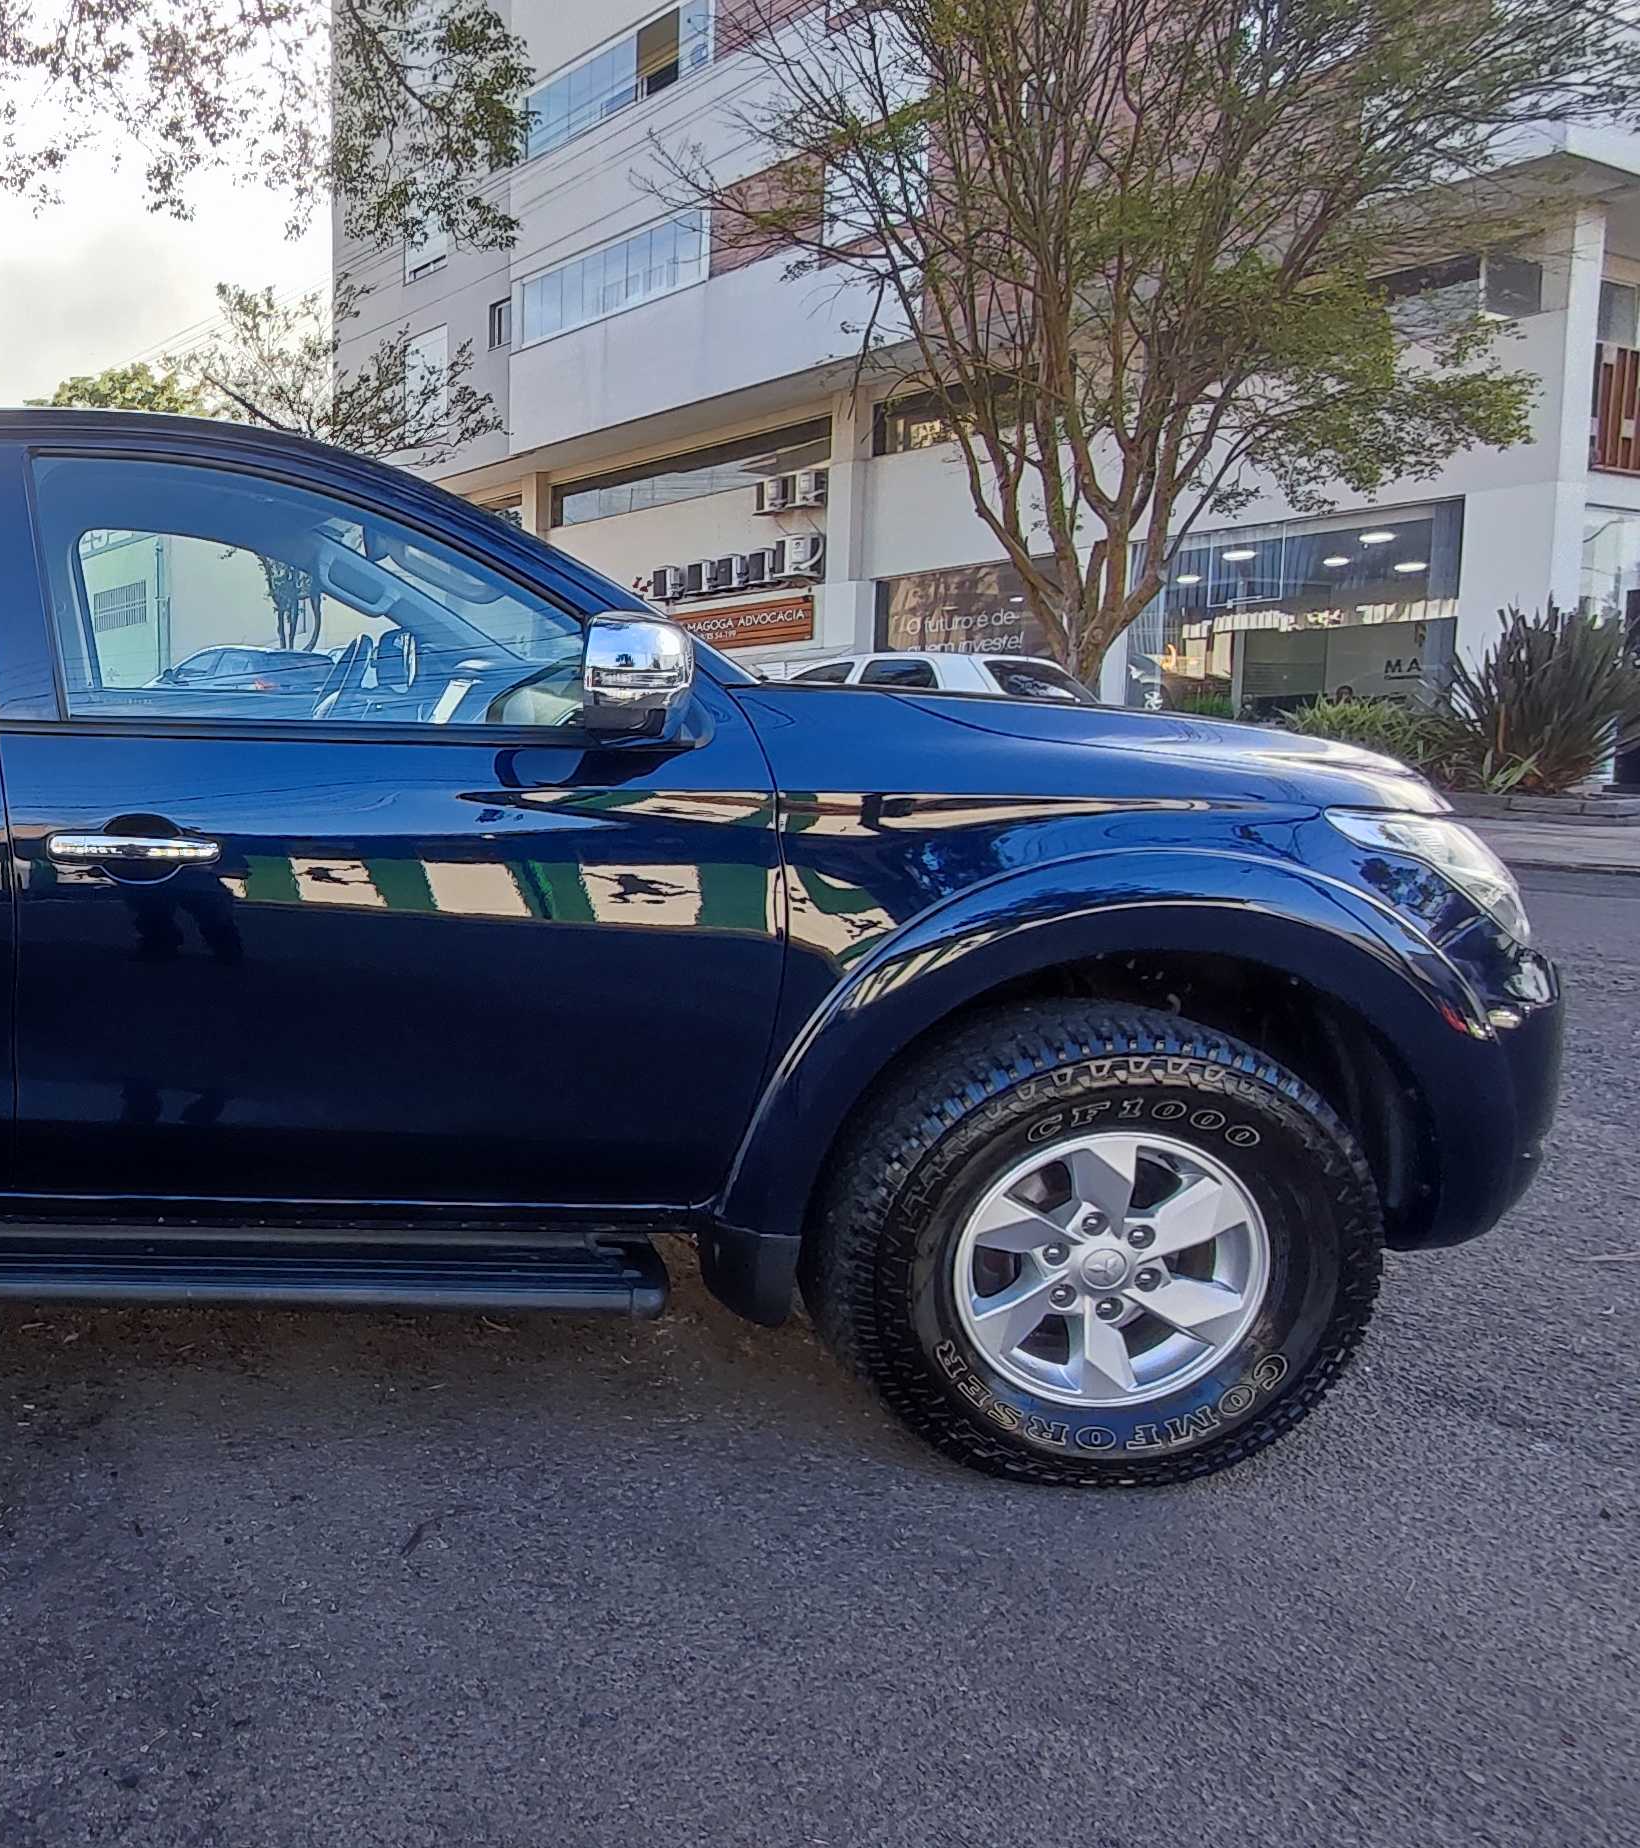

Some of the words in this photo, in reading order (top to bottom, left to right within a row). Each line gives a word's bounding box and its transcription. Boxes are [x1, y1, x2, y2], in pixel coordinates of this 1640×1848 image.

[687, 618, 735, 633] MAGOGA
[737, 608, 805, 627] ADVOCACIA
[906, 618, 922, 635] O
[924, 613, 973, 634] futuro
[976, 610, 989, 626] é
[958, 631, 1025, 653] investe!
[1027, 1098, 1260, 1147] CF1000
[934, 1340, 1289, 1450] COMFORSER
